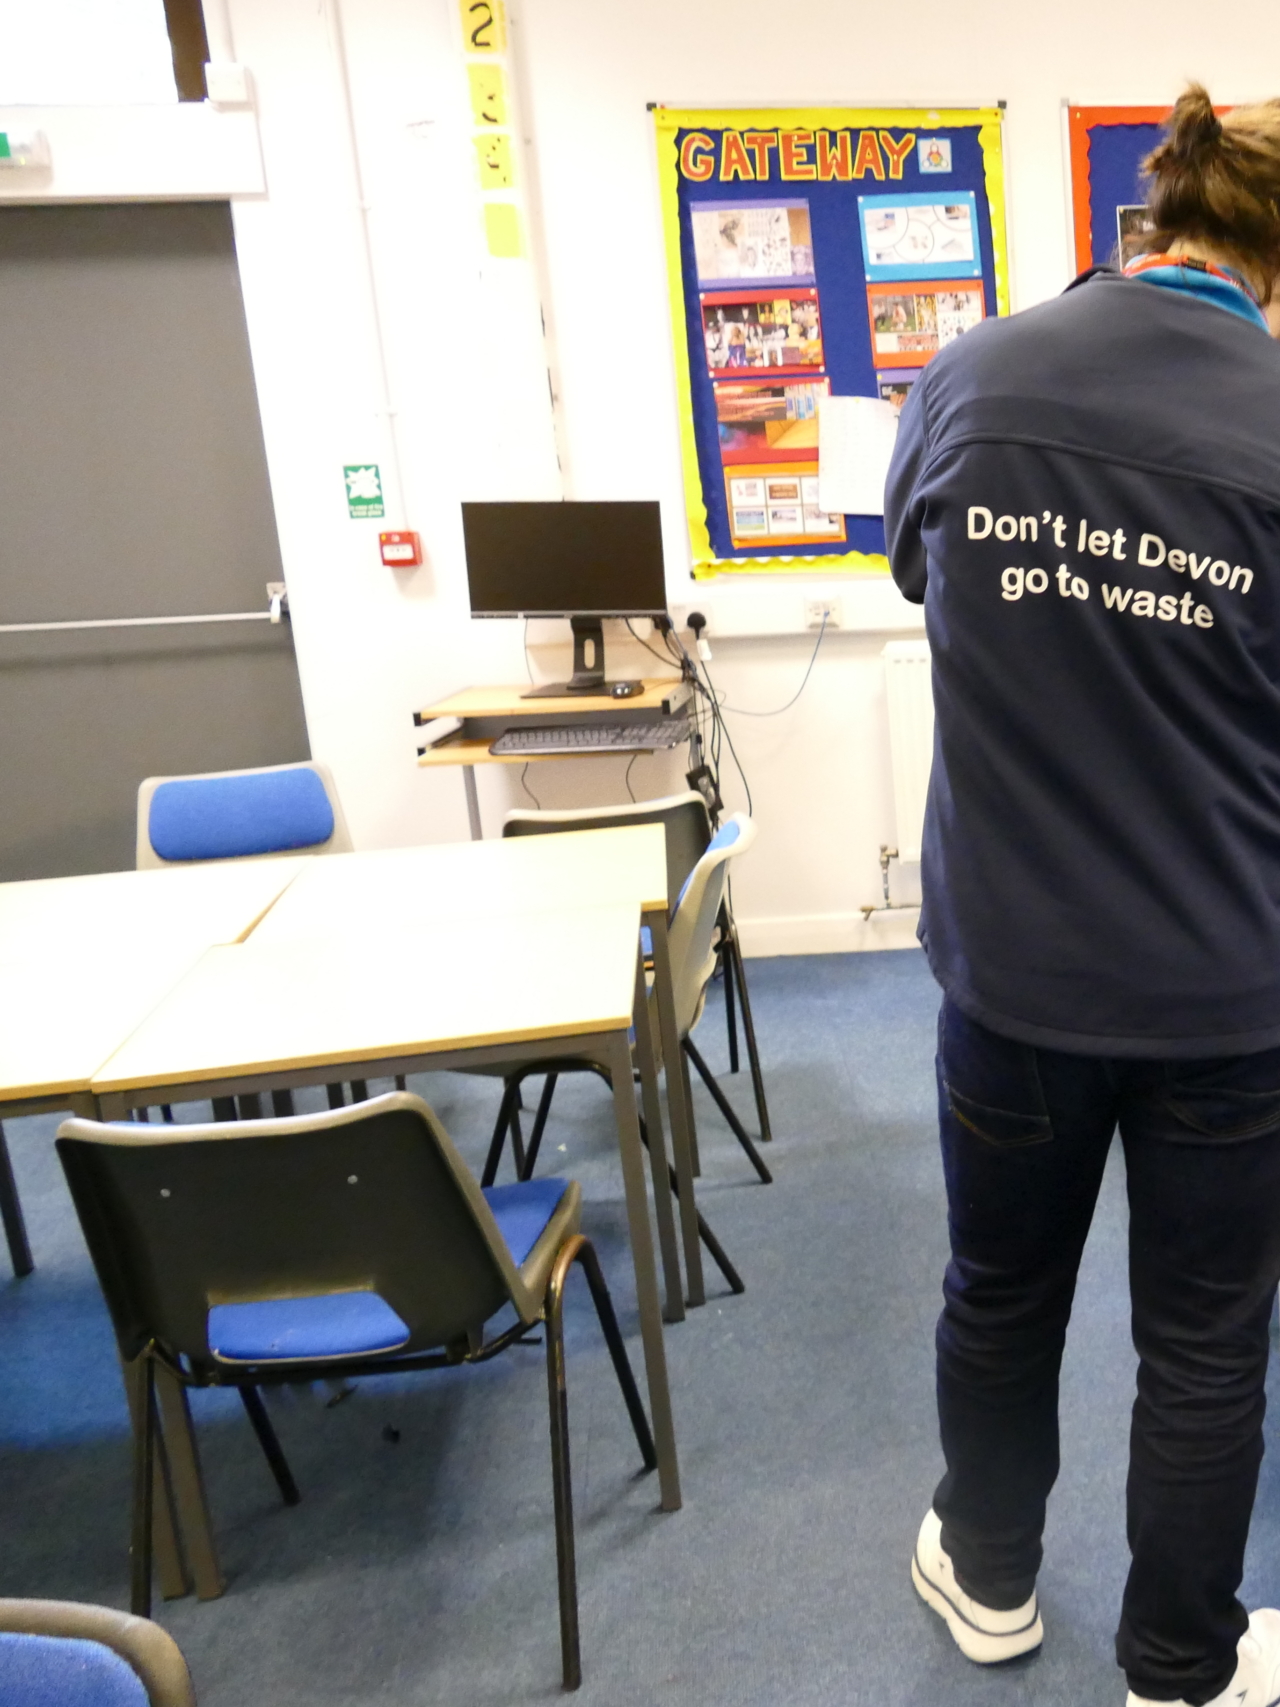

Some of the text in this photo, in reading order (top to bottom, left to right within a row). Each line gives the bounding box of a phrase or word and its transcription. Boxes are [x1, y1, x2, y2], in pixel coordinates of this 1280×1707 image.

[680, 131, 915, 182] GATEWAY
[967, 506, 1254, 594] Don't let Devon
[1001, 563, 1215, 629] go to waste
